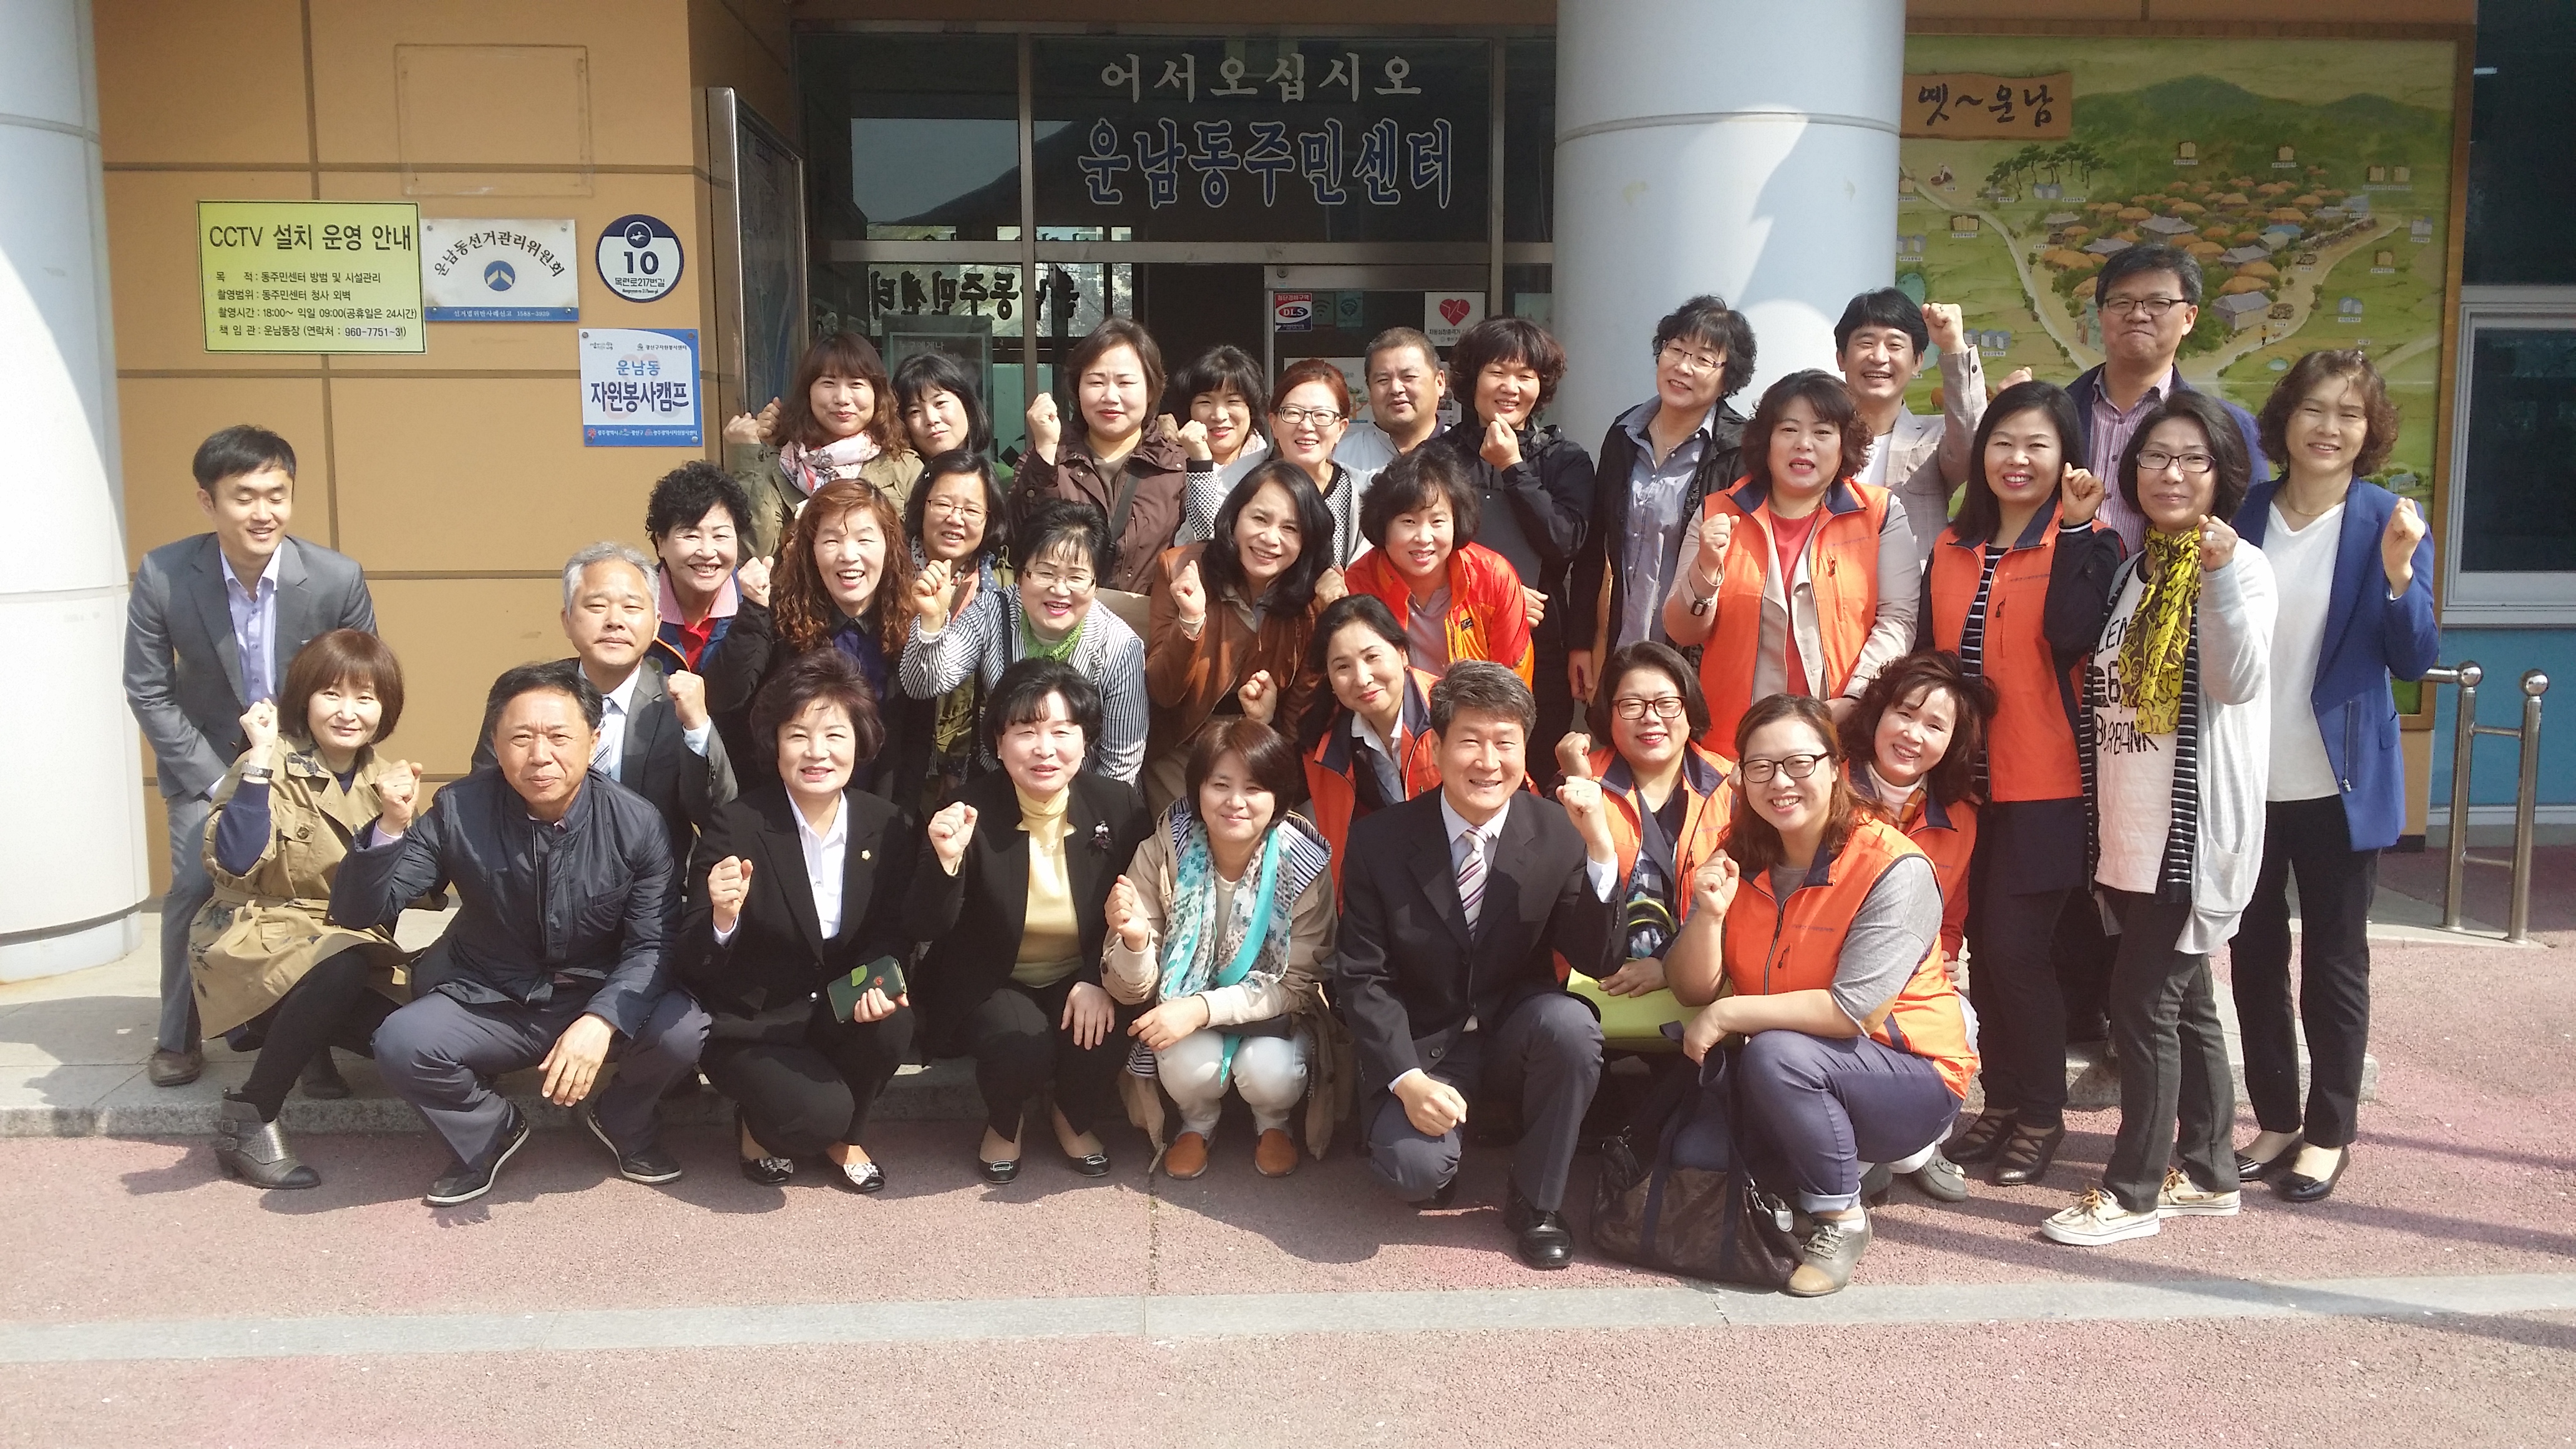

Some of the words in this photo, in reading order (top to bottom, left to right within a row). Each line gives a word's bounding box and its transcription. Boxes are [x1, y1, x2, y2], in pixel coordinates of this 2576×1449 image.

[1101, 52, 1422, 104] 어서오십시오
[1078, 117, 1452, 210] 운남동주민센터
[210, 226, 263, 246] CCTV
[273, 224, 312, 250] 설치
[322, 225, 362, 251] 운영
[372, 225, 411, 251] 안내
[434, 230, 565, 276] 운남동선거관리위원회
[623, 251, 659, 275] 10
[261, 271, 306, 283] 동주민센터
[310, 272, 328, 283] 방범
[332, 272, 341, 283] 및
[345, 272, 381, 283] 시설관리
[615, 277, 665, 287] 목련로217번길
[262, 290, 306, 301] 동주민센터
[311, 290, 329, 301] 청사
[333, 291, 351, 301] 외벽
[298, 308, 315, 318] 익일
[264, 325, 300, 336] 운남동장
[616, 360, 660, 376] 운남동
[591, 381, 689, 412] 자원봉사캠프
